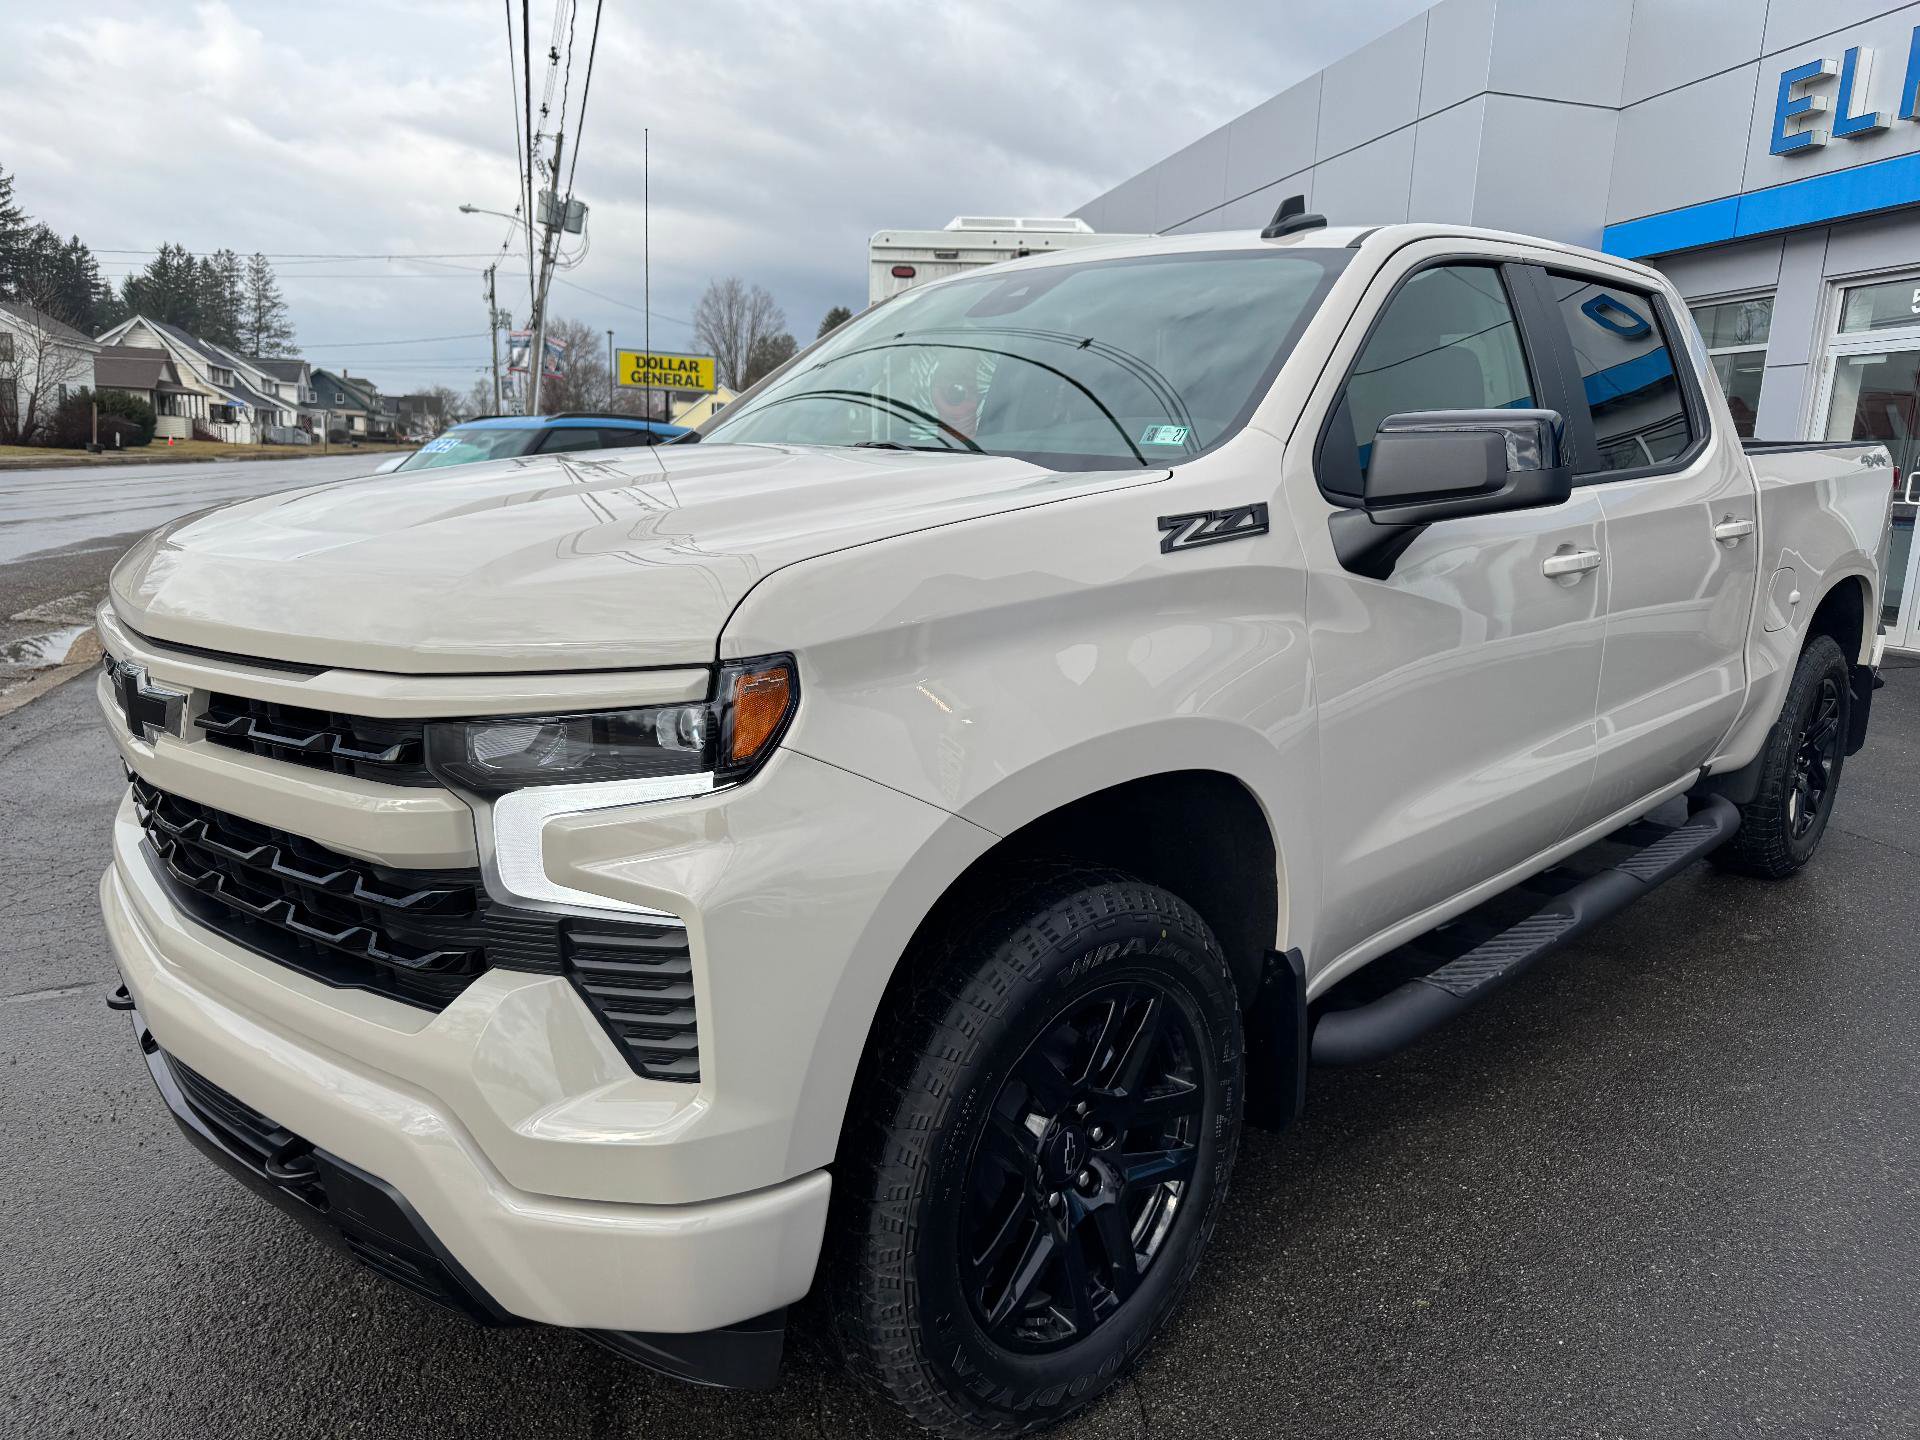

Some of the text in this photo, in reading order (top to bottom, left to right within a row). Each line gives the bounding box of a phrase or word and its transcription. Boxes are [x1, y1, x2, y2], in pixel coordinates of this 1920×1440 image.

[635, 356, 700, 373] DOLLAR
[631, 370, 704, 388] GENERAL
[1172, 428, 1188, 442] 27
[1157, 501, 1269, 555] Z71
